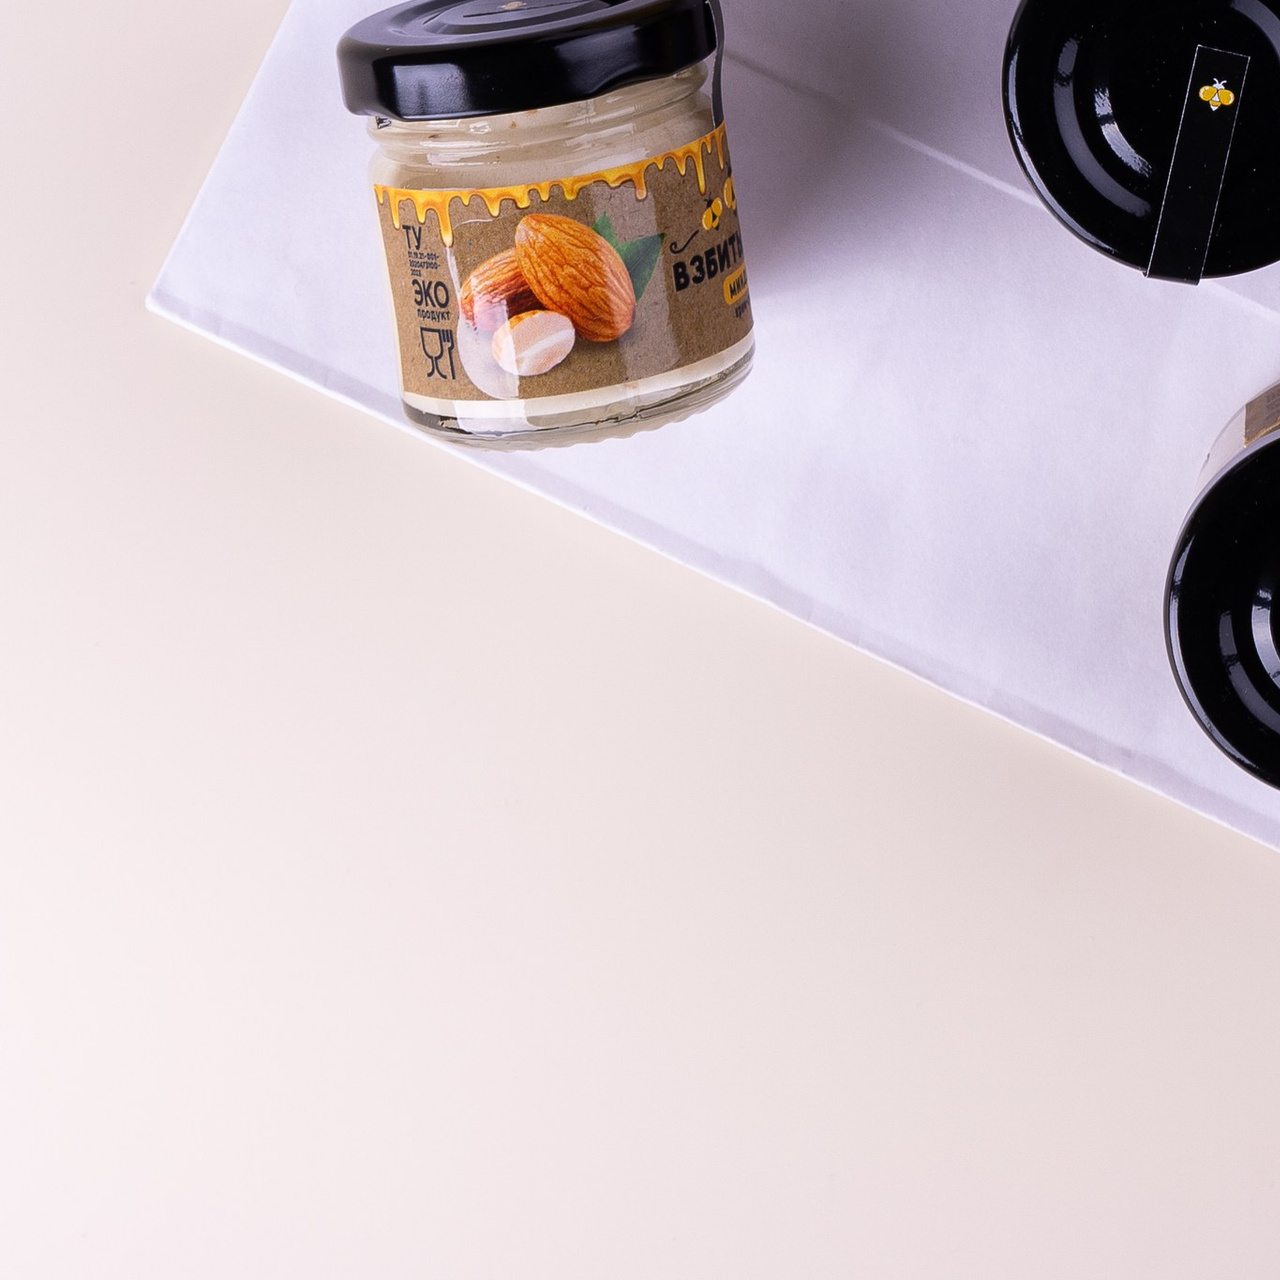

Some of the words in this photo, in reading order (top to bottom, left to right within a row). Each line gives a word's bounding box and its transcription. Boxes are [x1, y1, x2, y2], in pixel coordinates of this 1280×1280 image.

[402, 224, 422, 250] ТУ
[412, 279, 450, 309] ЭКО
[417, 308, 451, 323] продукт
